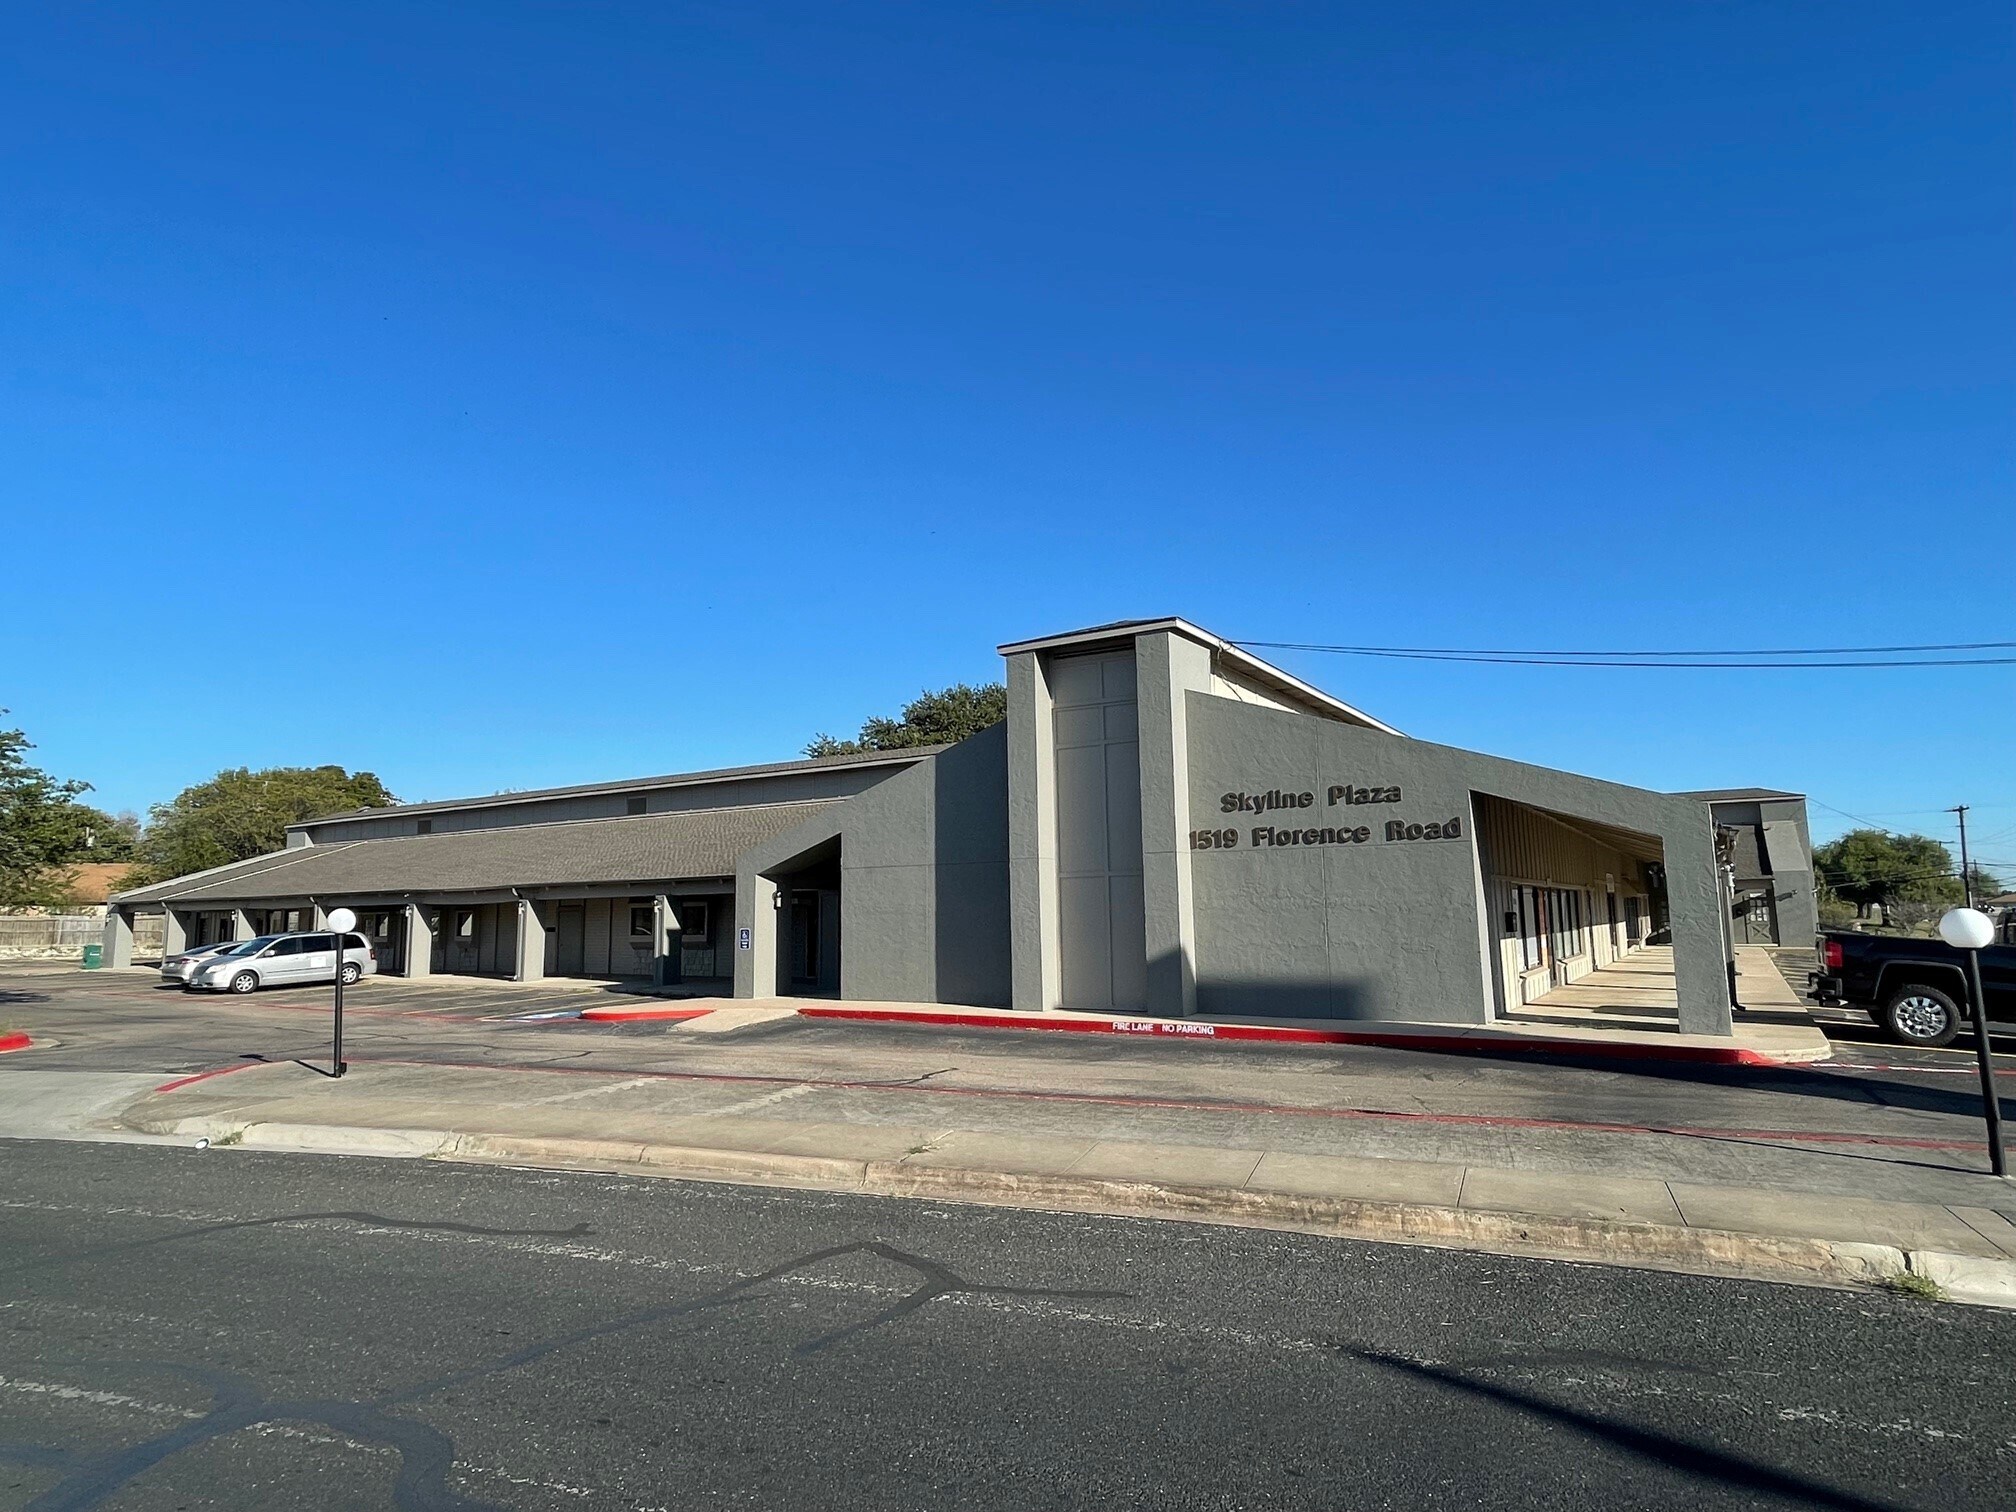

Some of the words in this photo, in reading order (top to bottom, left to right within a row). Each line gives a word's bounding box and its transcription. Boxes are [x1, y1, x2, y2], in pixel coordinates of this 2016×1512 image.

[1220, 789, 1314, 815] Skyline
[1328, 784, 1402, 806] Plaza
[1189, 828, 1239, 850] 1519
[1251, 825, 1371, 847] Florence
[1385, 816, 1462, 842] Road
[1112, 1021, 1130, 1031] FIRE
[1131, 1022, 1154, 1032] LANE
[1161, 1023, 1175, 1033] NO
[1176, 1024, 1215, 1035] PARKING
